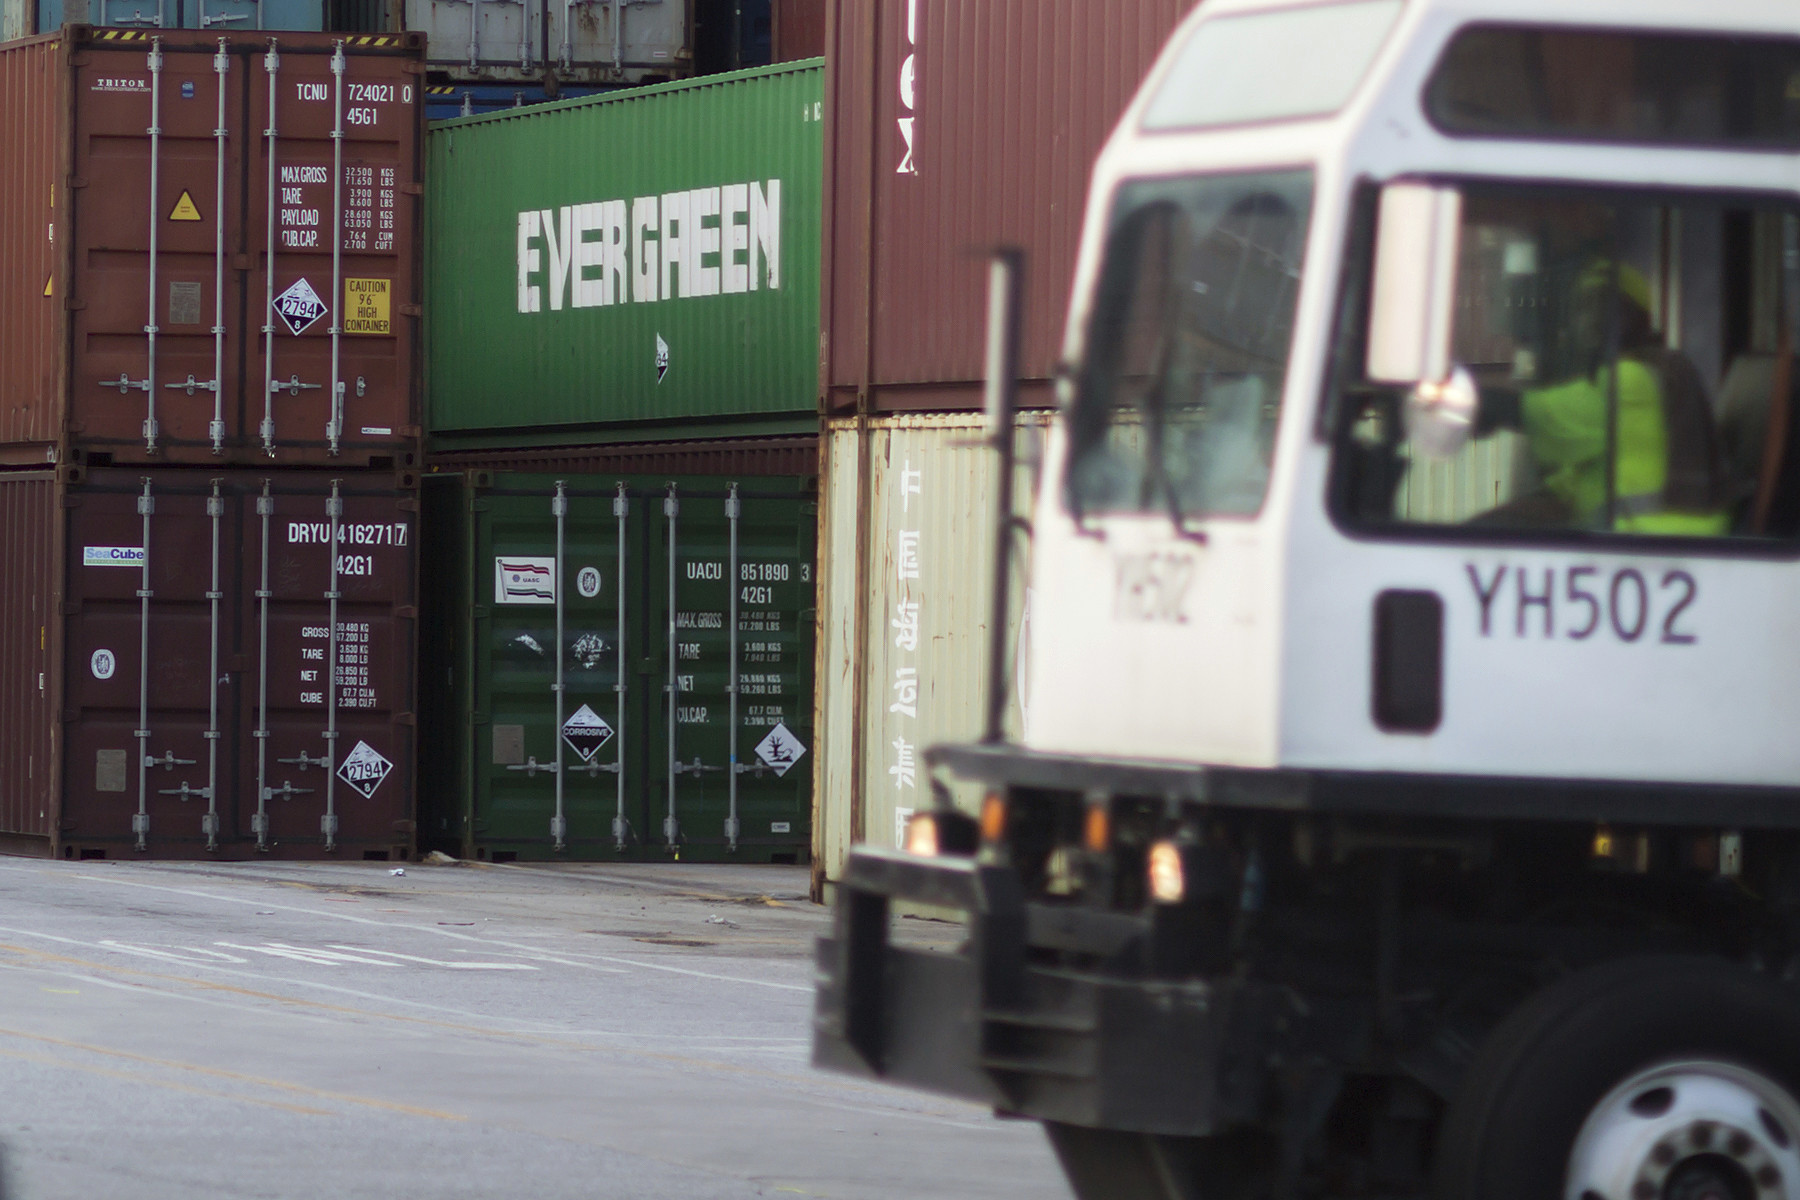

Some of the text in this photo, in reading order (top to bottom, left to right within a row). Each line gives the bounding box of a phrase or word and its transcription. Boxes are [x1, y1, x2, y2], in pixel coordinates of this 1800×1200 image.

[97, 79, 145, 87] TRITON
[297, 84, 411, 102] TCNU 724021 0
[347, 108, 377, 125] 45G1
[346, 167, 372, 176] 32.500
[381, 168, 394, 177] KGS
[346, 177, 394, 186] 71.650 LBS
[281, 188, 394, 204] TARE 3.900 KGS
[350, 198, 393, 207] 8.600 LBS
[281, 209, 393, 225] PAYLOAD 28.600 KGS
[345, 220, 393, 228] 63.050 LBS
[350, 231, 366, 240] 76.4
[344, 240, 366, 249] 2.700
[518, 179, 780, 313] EVERGREEN
[349, 280, 386, 293] CAUTION
[283, 299, 315, 318] 2794
[357, 307, 377, 318] HIGH
[294, 320, 301, 330] 8
[345, 319, 389, 332] CONTAINER
[288, 523, 330, 543] DRYU
[337, 524, 392, 544] 416271
[86, 548, 144, 560] SeaCube
[336, 555, 372, 575] 42G1
[687, 562, 809, 581] UACU 851890 3
[741, 587, 772, 603] 42G1
[1466, 564, 1698, 646] YH502
[302, 623, 369, 638] GROSS 30.480 KG
[766, 622, 780, 631] LBS
[336, 633, 369, 642] 67.200 LB
[302, 645, 368, 659] TARE 3.630 KG
[679, 643, 781, 659] TARE KGS
[340, 655, 368, 664] 8.000 LB
[301, 671, 318, 681] NET
[359, 667, 368, 675] KG
[359, 677, 368, 686] LB
[678, 675, 694, 691] NET
[301, 688, 357, 703] CUBE 67.7
[768, 685, 781, 694] LBS
[563, 728, 608, 736] CORROSIVE
[583, 747, 589, 756] 8
[349, 761, 381, 780] 2794
[364, 783, 371, 792] 8
